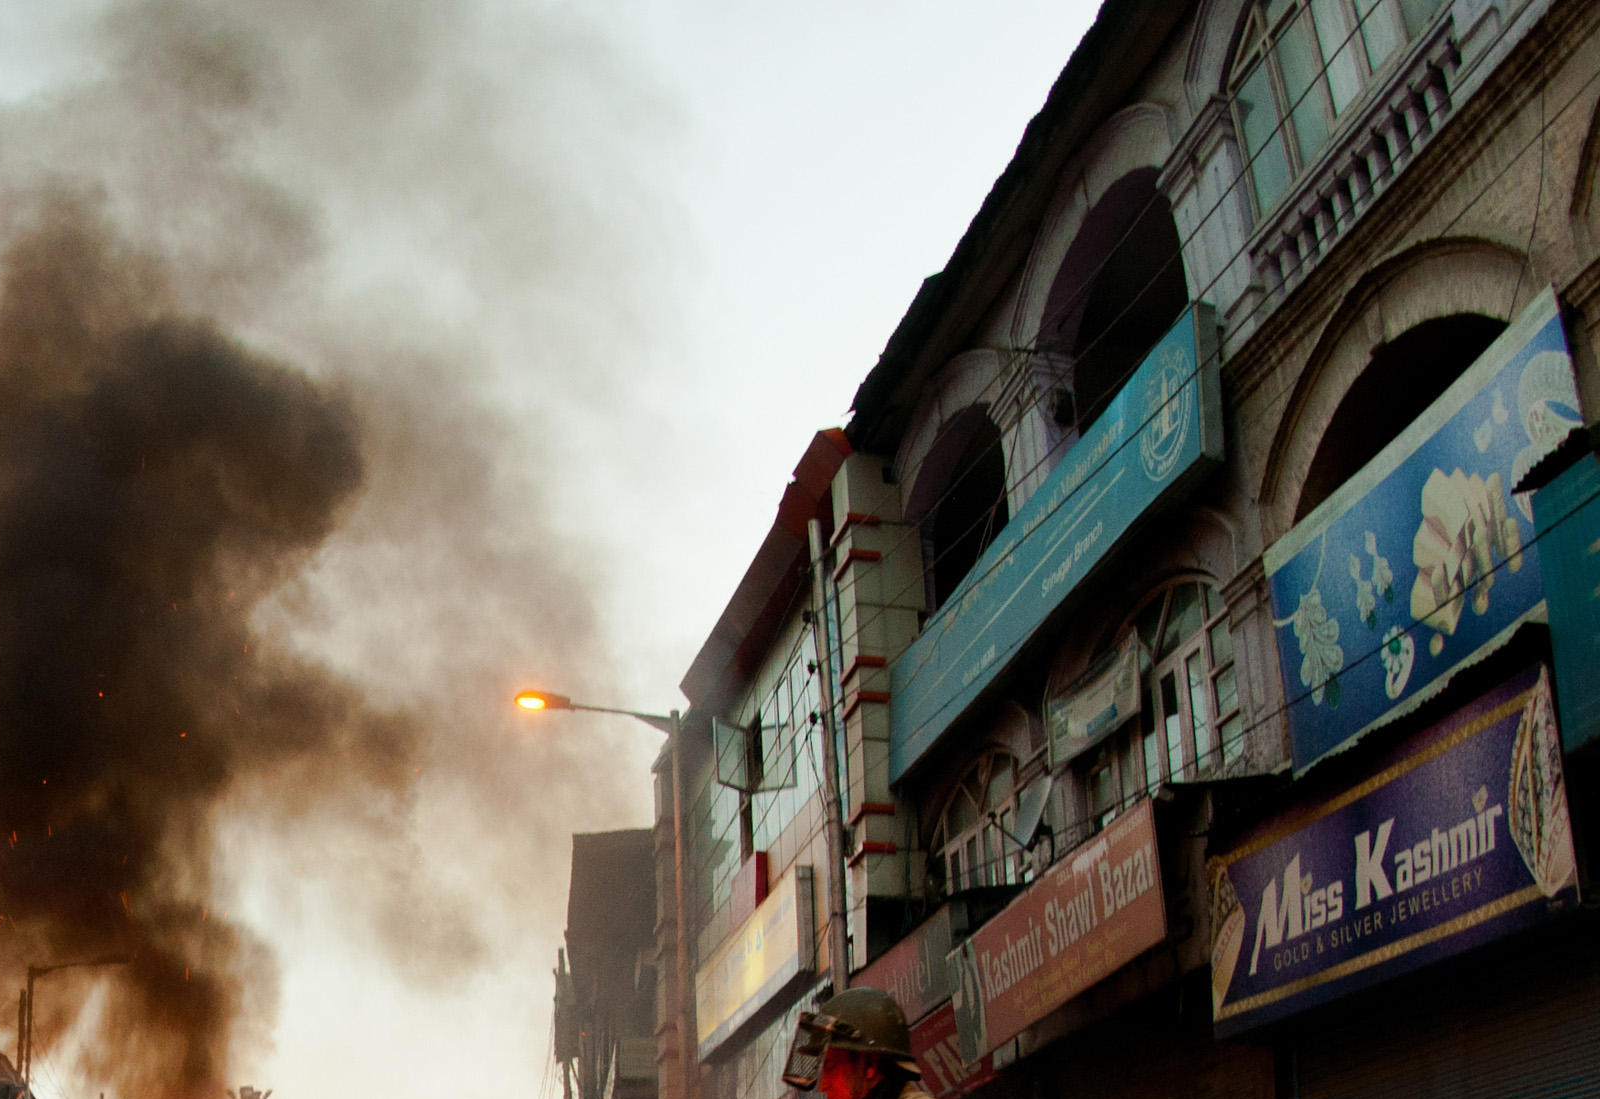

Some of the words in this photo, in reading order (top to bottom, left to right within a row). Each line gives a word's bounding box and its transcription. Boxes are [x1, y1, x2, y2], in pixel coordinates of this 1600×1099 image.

[1074, 520, 1102, 563] Branch
[981, 916, 1044, 1003] Kashmir
[1044, 874, 1098, 957] Shawl
[1098, 843, 1155, 920] Bazar
[1249, 851, 1344, 976] Miss
[1355, 785, 1502, 910] Kashmir
[1273, 943, 1310, 971] GOLD
[1316, 937, 1326, 955] &
[1330, 912, 1383, 948] SILVER
[1390, 866, 1484, 927] JEWELLERY
